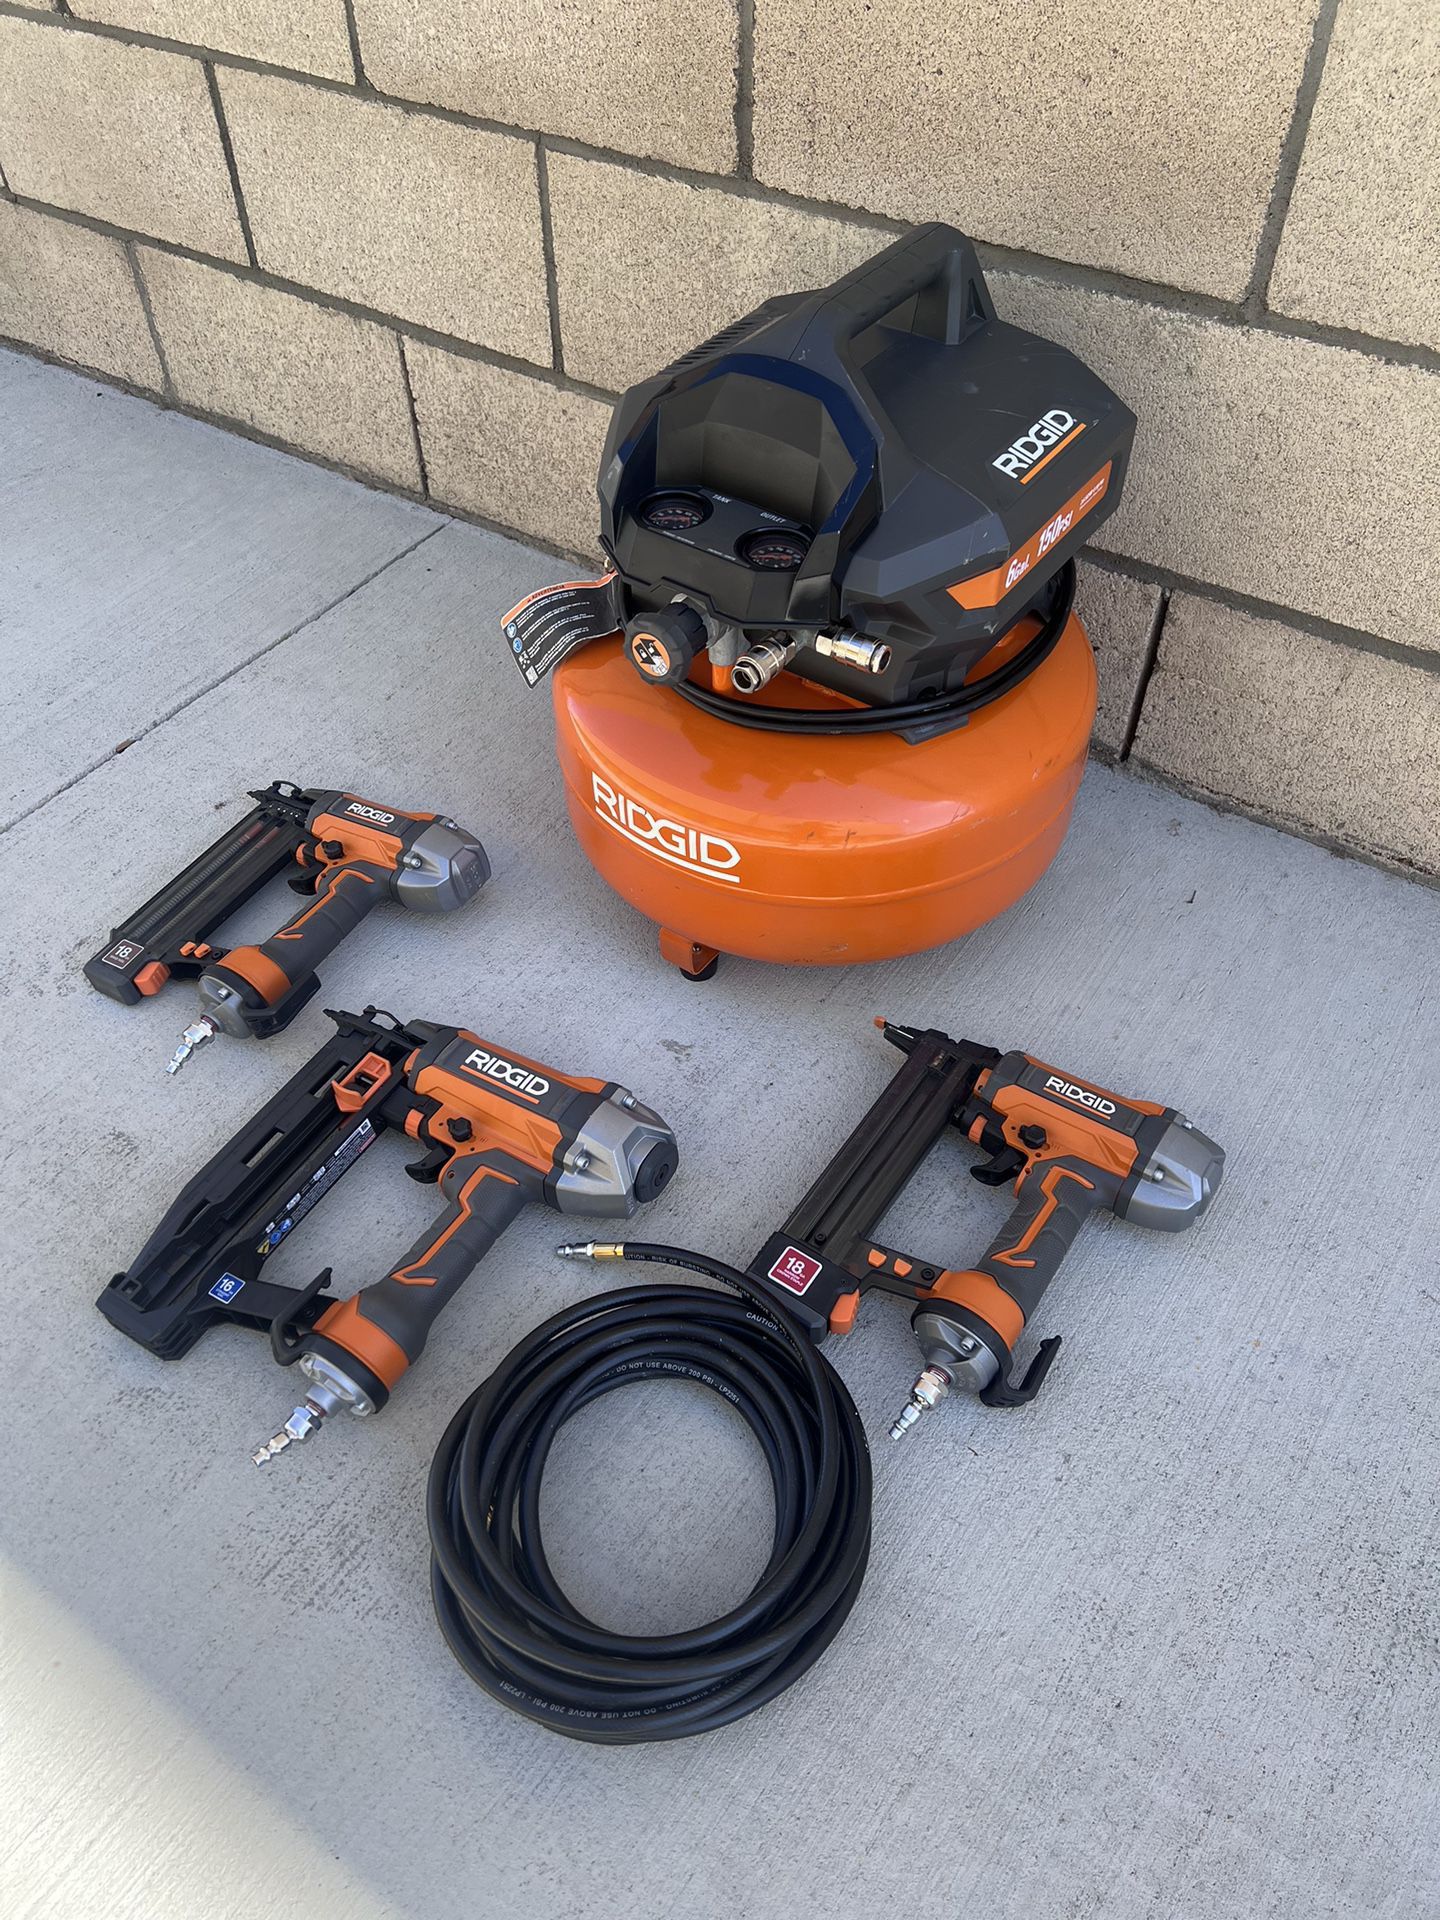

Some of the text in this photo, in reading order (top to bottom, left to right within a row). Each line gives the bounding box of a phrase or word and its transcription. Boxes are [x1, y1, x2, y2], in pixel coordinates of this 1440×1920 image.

[992, 409, 1075, 479] RIDGID
[712, 494, 731, 504] TANK
[760, 512, 787, 524] OUTLET
[347, 802, 395, 823] RIDGID
[591, 771, 741, 869] RIDGID
[114, 944, 132, 958] 18
[465, 1049, 550, 1096] RIDGID
[1045, 1075, 1116, 1115] RIDGID
[786, 1256, 806, 1275] 18
[220, 1278, 235, 1292] 16
[746, 1312, 779, 1331] CAUTION
[616, 1365, 627, 1373] DO
[628, 1361, 643, 1369] NOT
[662, 1362, 687, 1374] ABOVE
[688, 1369, 701, 1379] 200
[702, 1374, 714, 1385] PSI
[718, 1385, 740, 1404] LP2251
[499, 1680, 526, 1699] LP2251
[532, 1698, 548, 1709] PSI
[549, 1703, 566, 1714] 200
[643, 1707, 657, 1715] DO
[568, 1708, 598, 1718] ABOVE
[622, 1711, 641, 1719] NOT
